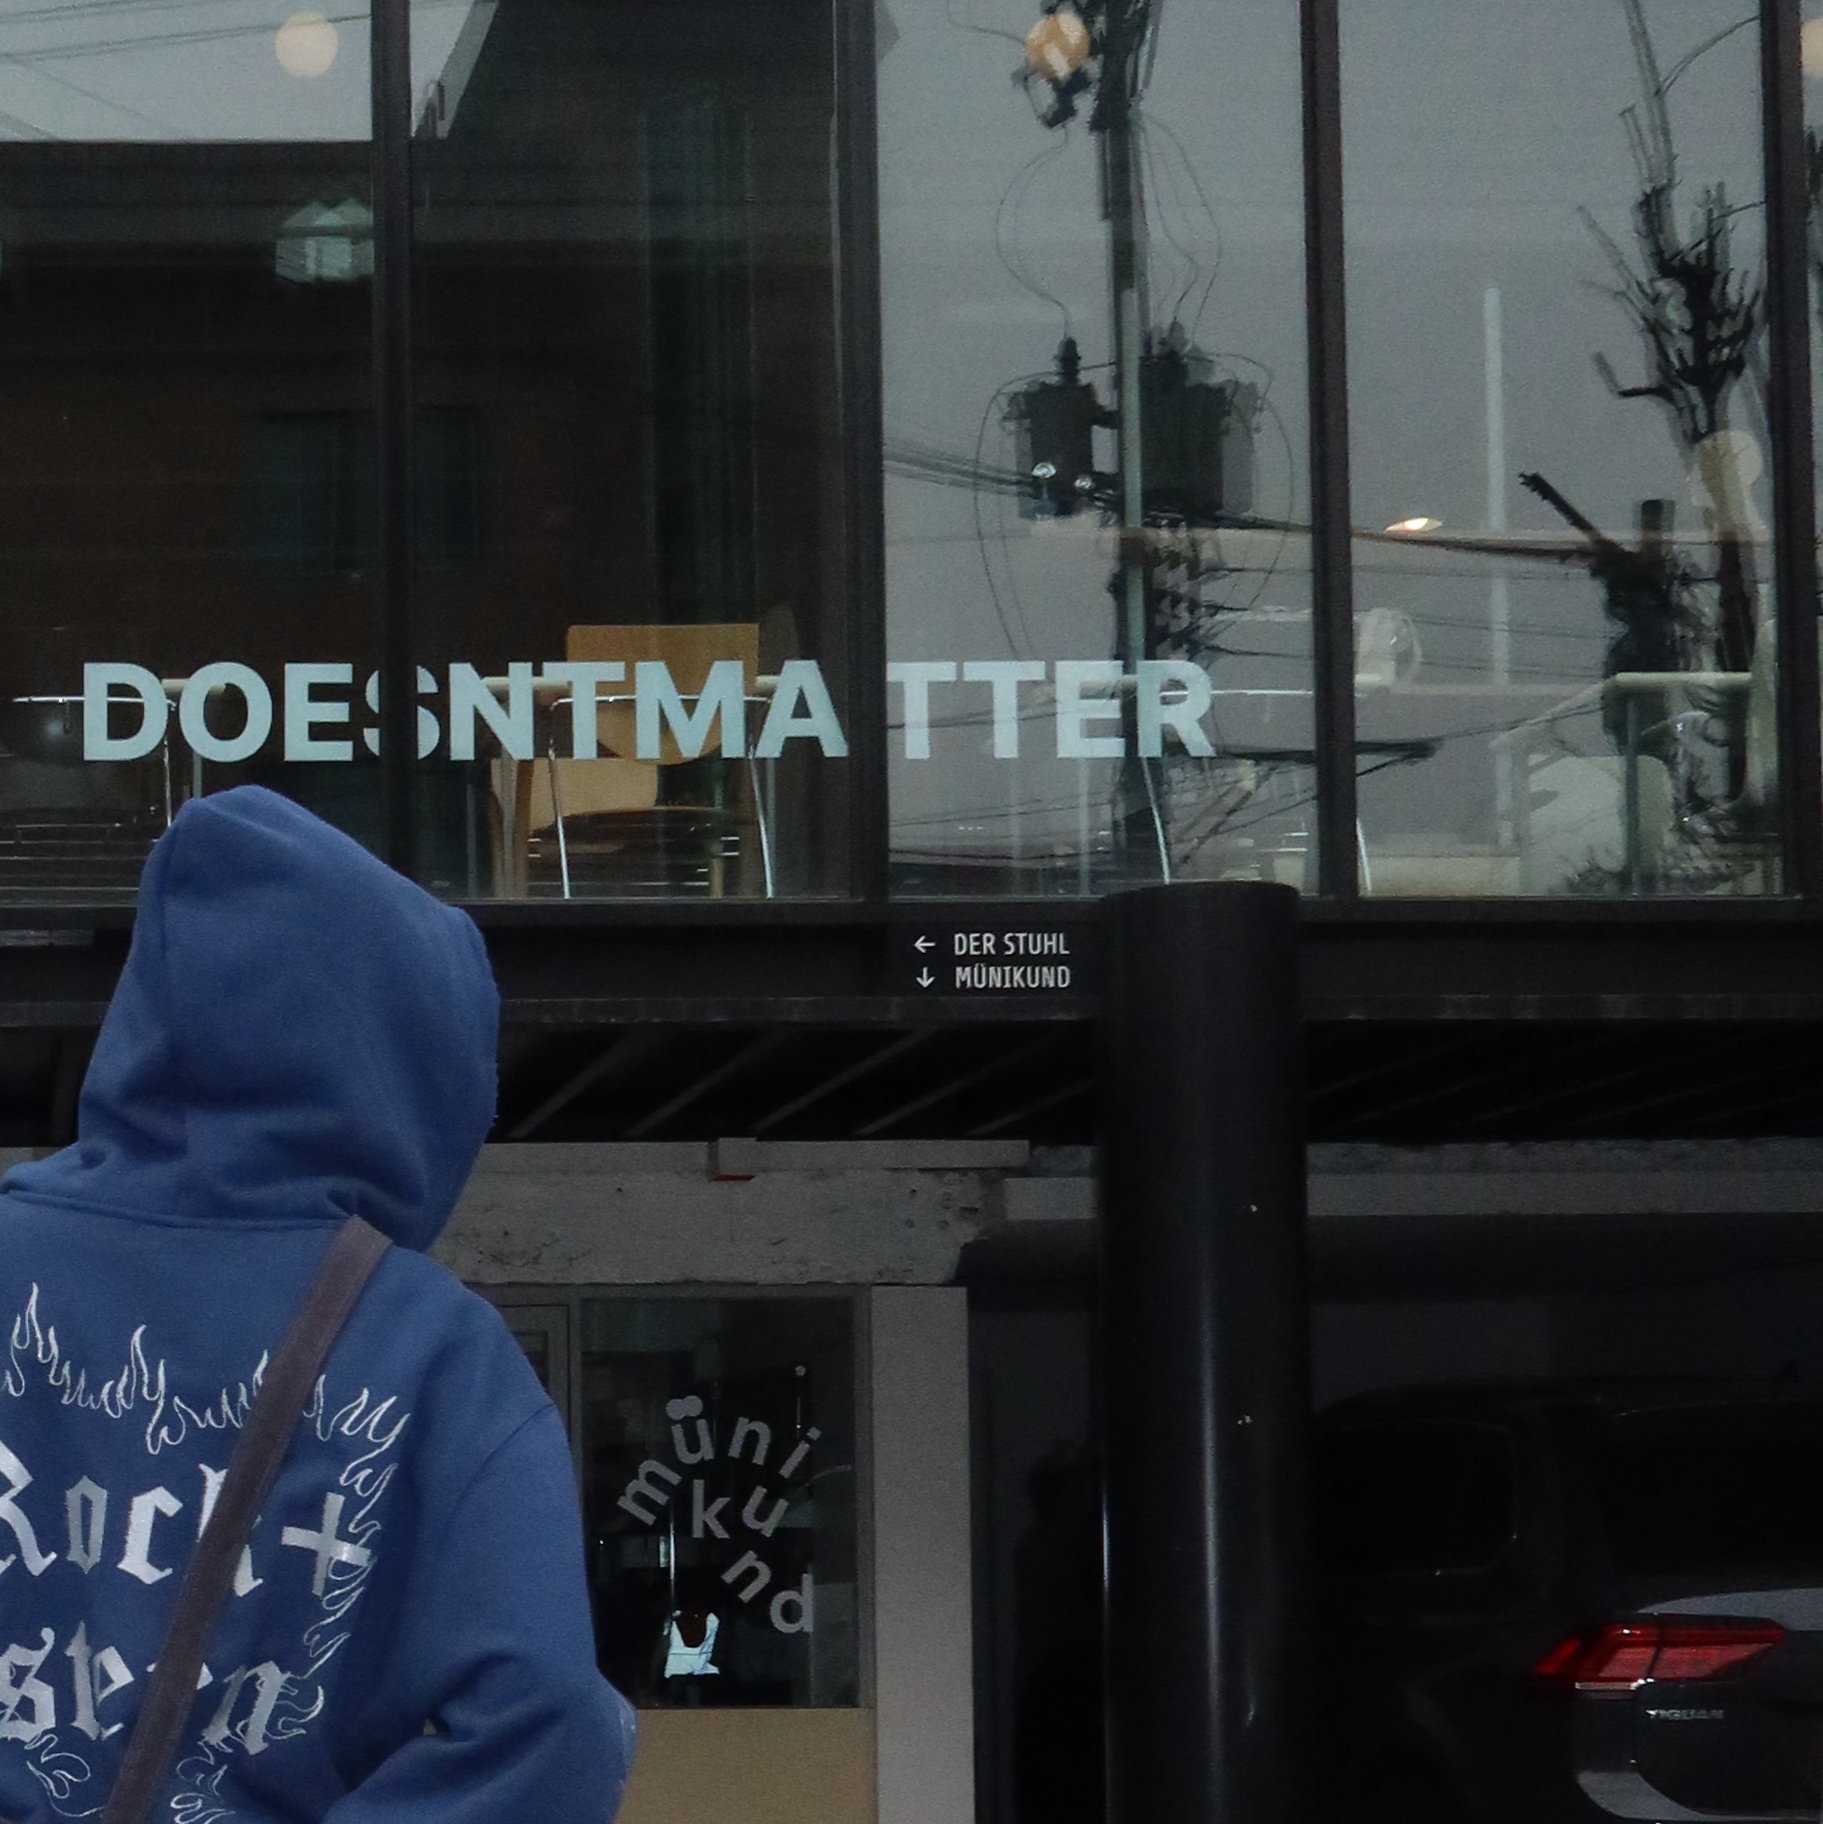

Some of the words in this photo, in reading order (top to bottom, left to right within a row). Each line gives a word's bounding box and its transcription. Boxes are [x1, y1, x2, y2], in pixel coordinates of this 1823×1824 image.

[953, 932, 996, 956] DER
[1003, 932, 1071, 956] STUHL
[954, 962, 1071, 989] MÜNIKUND
